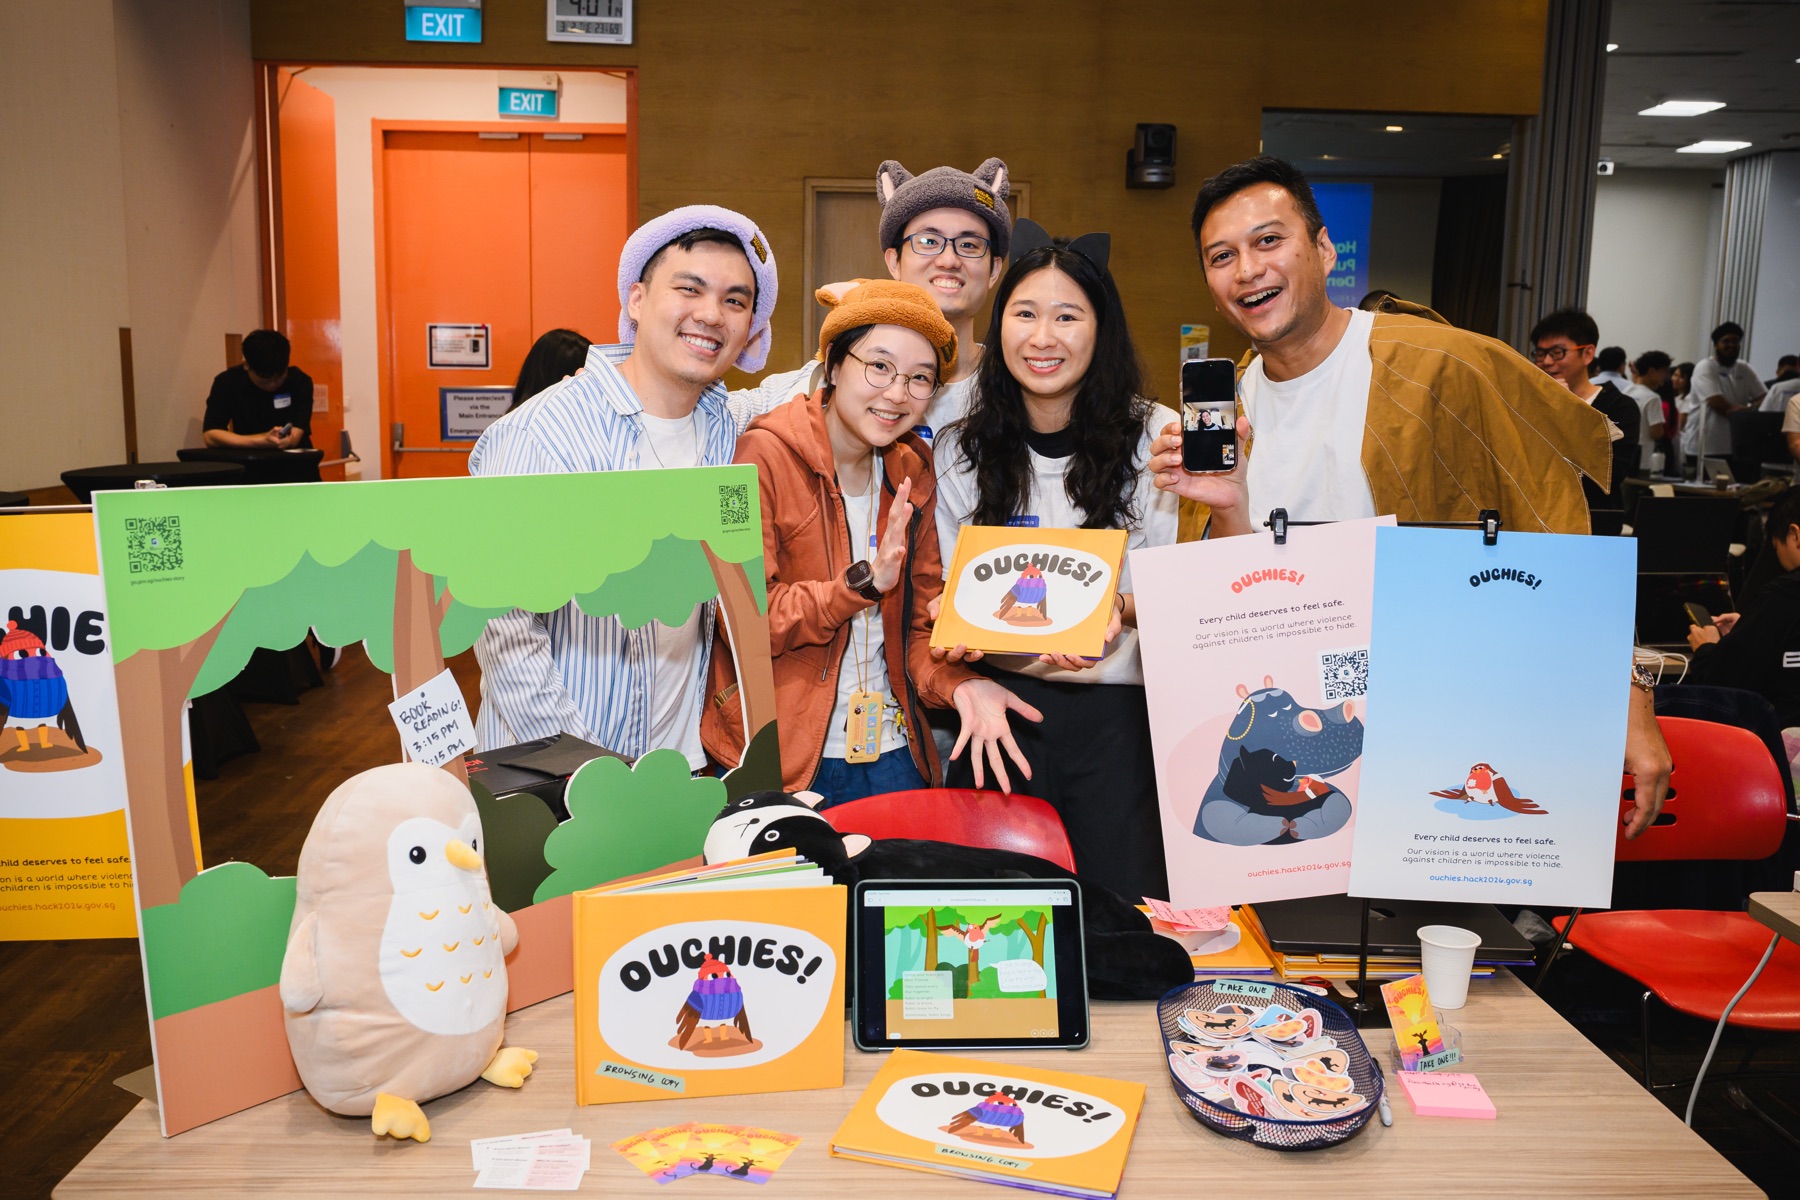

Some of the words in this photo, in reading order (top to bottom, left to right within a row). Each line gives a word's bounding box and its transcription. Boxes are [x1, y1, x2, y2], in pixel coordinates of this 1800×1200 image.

[421, 13, 464, 37] EXIT
[510, 93, 544, 112] EXIT
[973, 553, 1103, 588] OUCHIES!
[1231, 568, 1305, 594] OUCHIES!
[1469, 568, 1542, 590] OUCHIES!
[1199, 616, 1224, 625] Every
[1225, 612, 1246, 621] child
[1248, 607, 1288, 618] deserves
[1303, 602, 1320, 611] feel
[1322, 599, 1345, 609] safe.
[0, 605, 105, 655] HIE
[1192, 639, 1226, 651] against
[1229, 634, 1264, 645] children
[1276, 626, 1322, 638] impossible
[1336, 621, 1357, 630] hide.
[1195, 633, 1211, 641] Our
[1213, 629, 1239, 638] vision
[1260, 623, 1285, 632] world
[1287, 619, 1315, 629] where
[1316, 614, 1352, 624] violence
[399, 700, 432, 725] BOOK
[413, 699, 462, 733] READING!
[412, 731, 440, 753] 3:15
[440, 719, 459, 739] PM
[422, 751, 446, 765] :15
[447, 739, 465, 755] PM
[1414, 833, 1438, 842] Every
[1440, 834, 1460, 842] child
[1462, 835, 1501, 844] deserves
[1515, 837, 1532, 845] feel
[1534, 837, 1556, 846] safe.
[0, 859, 20, 867] hild
[22, 858, 68, 866] deserves
[85, 856, 104, 865] feel
[1402, 855, 1435, 864] against
[1437, 856, 1472, 865] children
[1474, 857, 1482, 865] is
[1484, 858, 1529, 867] impossible
[1531, 860, 1541, 868] to
[1543, 860, 1563, 869] hide.
[1407, 847, 1422, 855] Our
[1424, 848, 1450, 856] vision
[1452, 849, 1459, 857] is
[1470, 850, 1495, 858] world
[1497, 851, 1523, 859] where
[1526, 851, 1560, 860] violence
[14, 875, 23, 883] is
[36, 874, 64, 882] world
[1247, 860, 1352, 878] ouchies.hack2026.gov.sg
[0, 884, 41, 892] children
[43, 883, 52, 891] is
[55, 882, 106, 892] impossible
[1429, 874, 1533, 887] ouchies.hack2026.gov.sg
[619, 935, 823, 992] OUCHIES!
[1219, 983, 1243, 993] TAKE
[1248, 985, 1267, 994] ONE
[1393, 987, 1425, 1004] OUCHIES!
[1420, 1059, 1435, 1071] TAKE
[1437, 1052, 1457, 1066] ONE!!!
[604, 1065, 655, 1084] BROWSING
[661, 1077, 680, 1088] COPY
[911, 1080, 1112, 1124] OUCHIES!
[694, 1128, 745, 1138] OUCHIES!
[746, 1133, 795, 1147] OUCHIES!
[941, 1148, 994, 1163] BROWSING
[998, 1158, 1019, 1168] COPY
